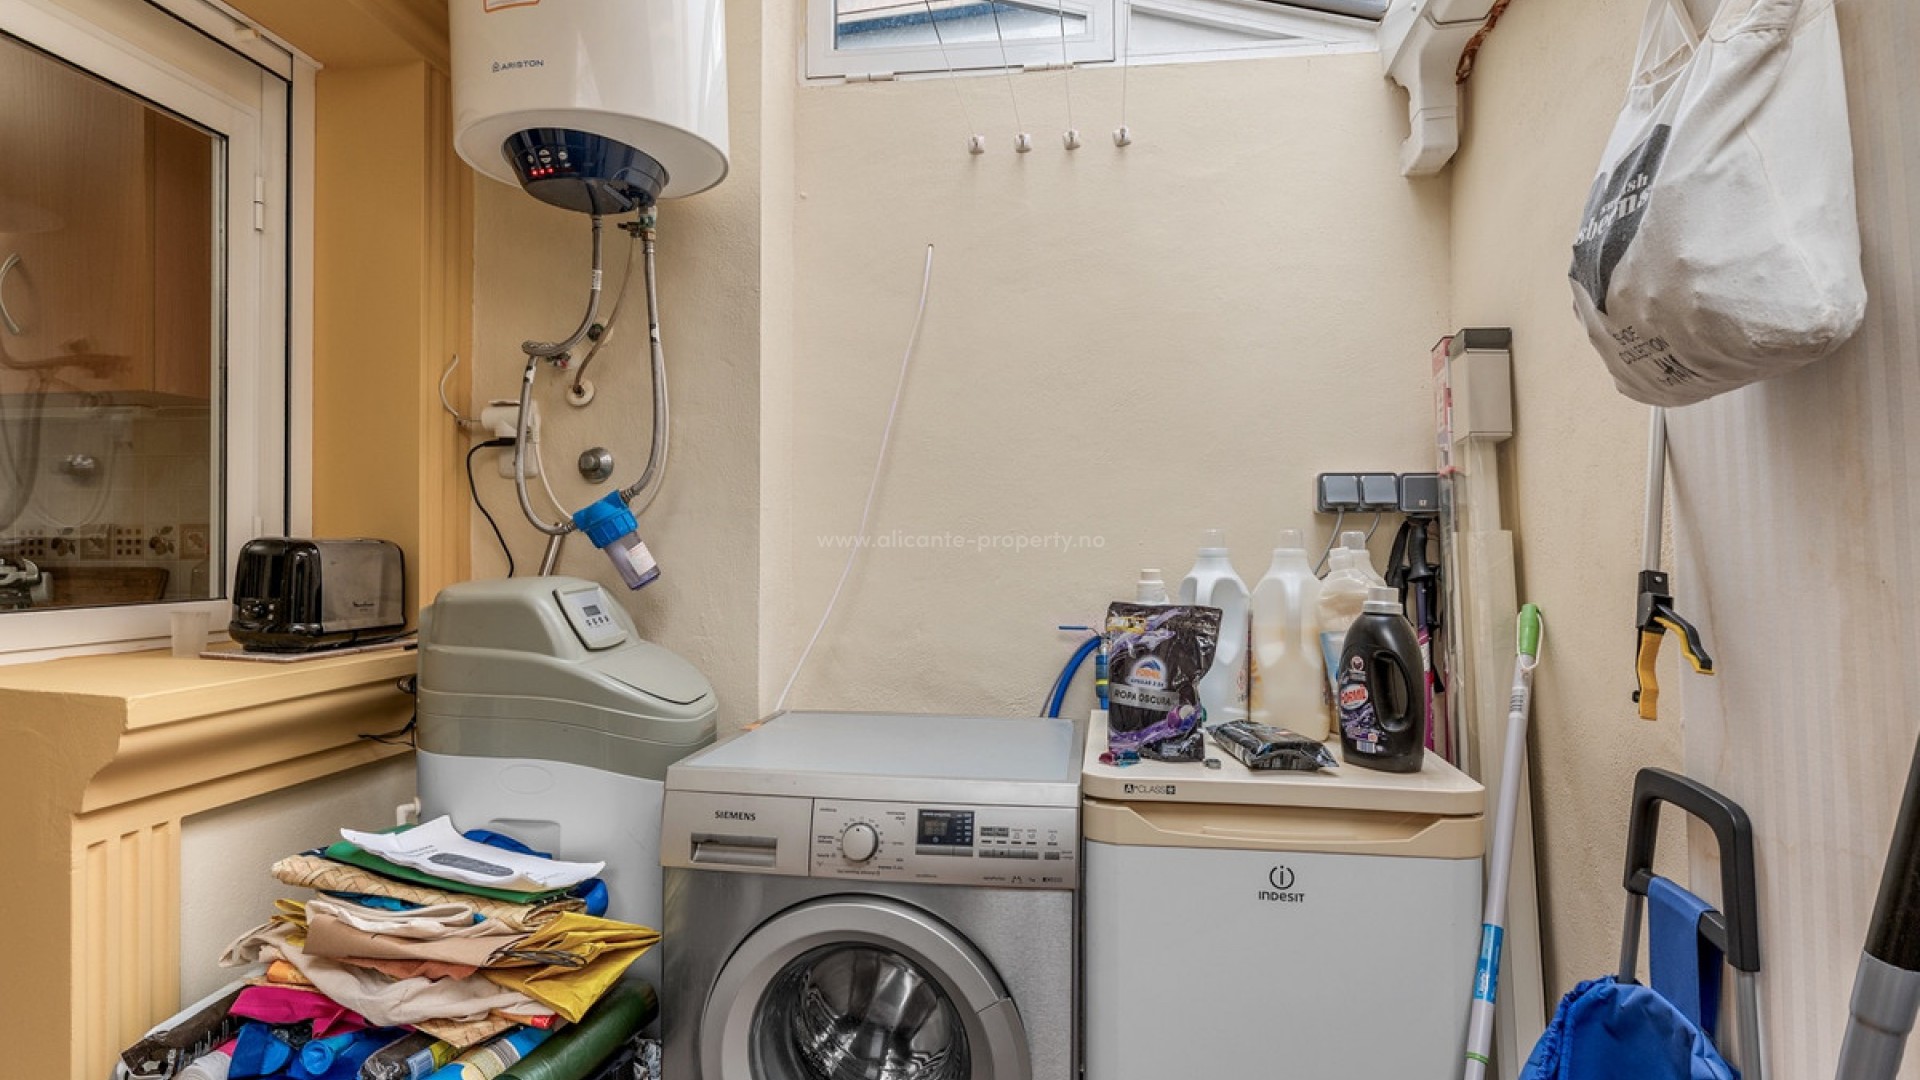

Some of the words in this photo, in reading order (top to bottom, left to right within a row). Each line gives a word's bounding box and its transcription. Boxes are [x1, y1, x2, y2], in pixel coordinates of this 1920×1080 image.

[501, 60, 544, 70] ARISTON
[1114, 688, 1137, 701] ROPA
[1138, 691, 1172, 706] OSCURA
[714, 810, 756, 820] SIEMENS
